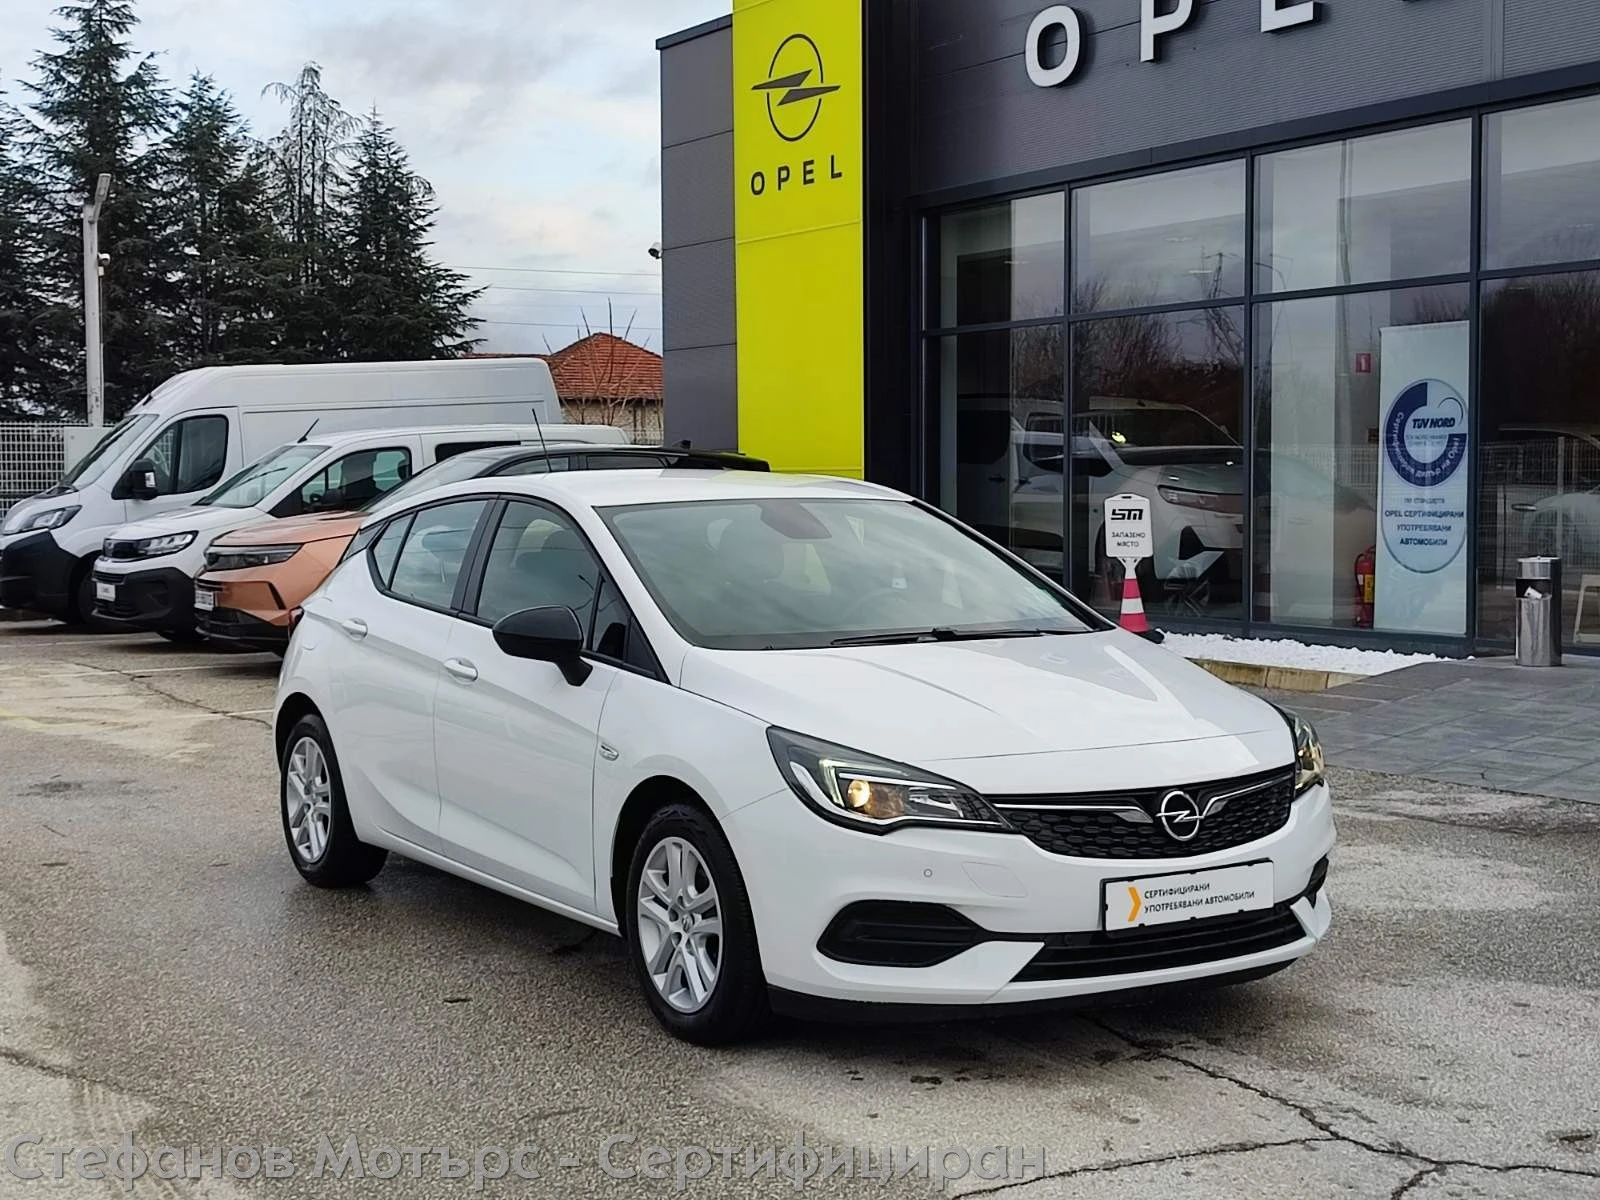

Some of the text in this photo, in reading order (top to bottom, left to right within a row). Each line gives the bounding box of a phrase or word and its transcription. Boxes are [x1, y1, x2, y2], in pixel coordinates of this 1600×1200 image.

[750, 154, 843, 196] OPEL
[1430, 418, 1455, 428] NORD
[1384, 510, 1403, 518] OPEL
[1144, 883, 1210, 899] СЕРТИФИЦИРАНИ
[1144, 890, 1255, 914] УПОТРЕБЯВАНИ АВТОМОБИЛИ
